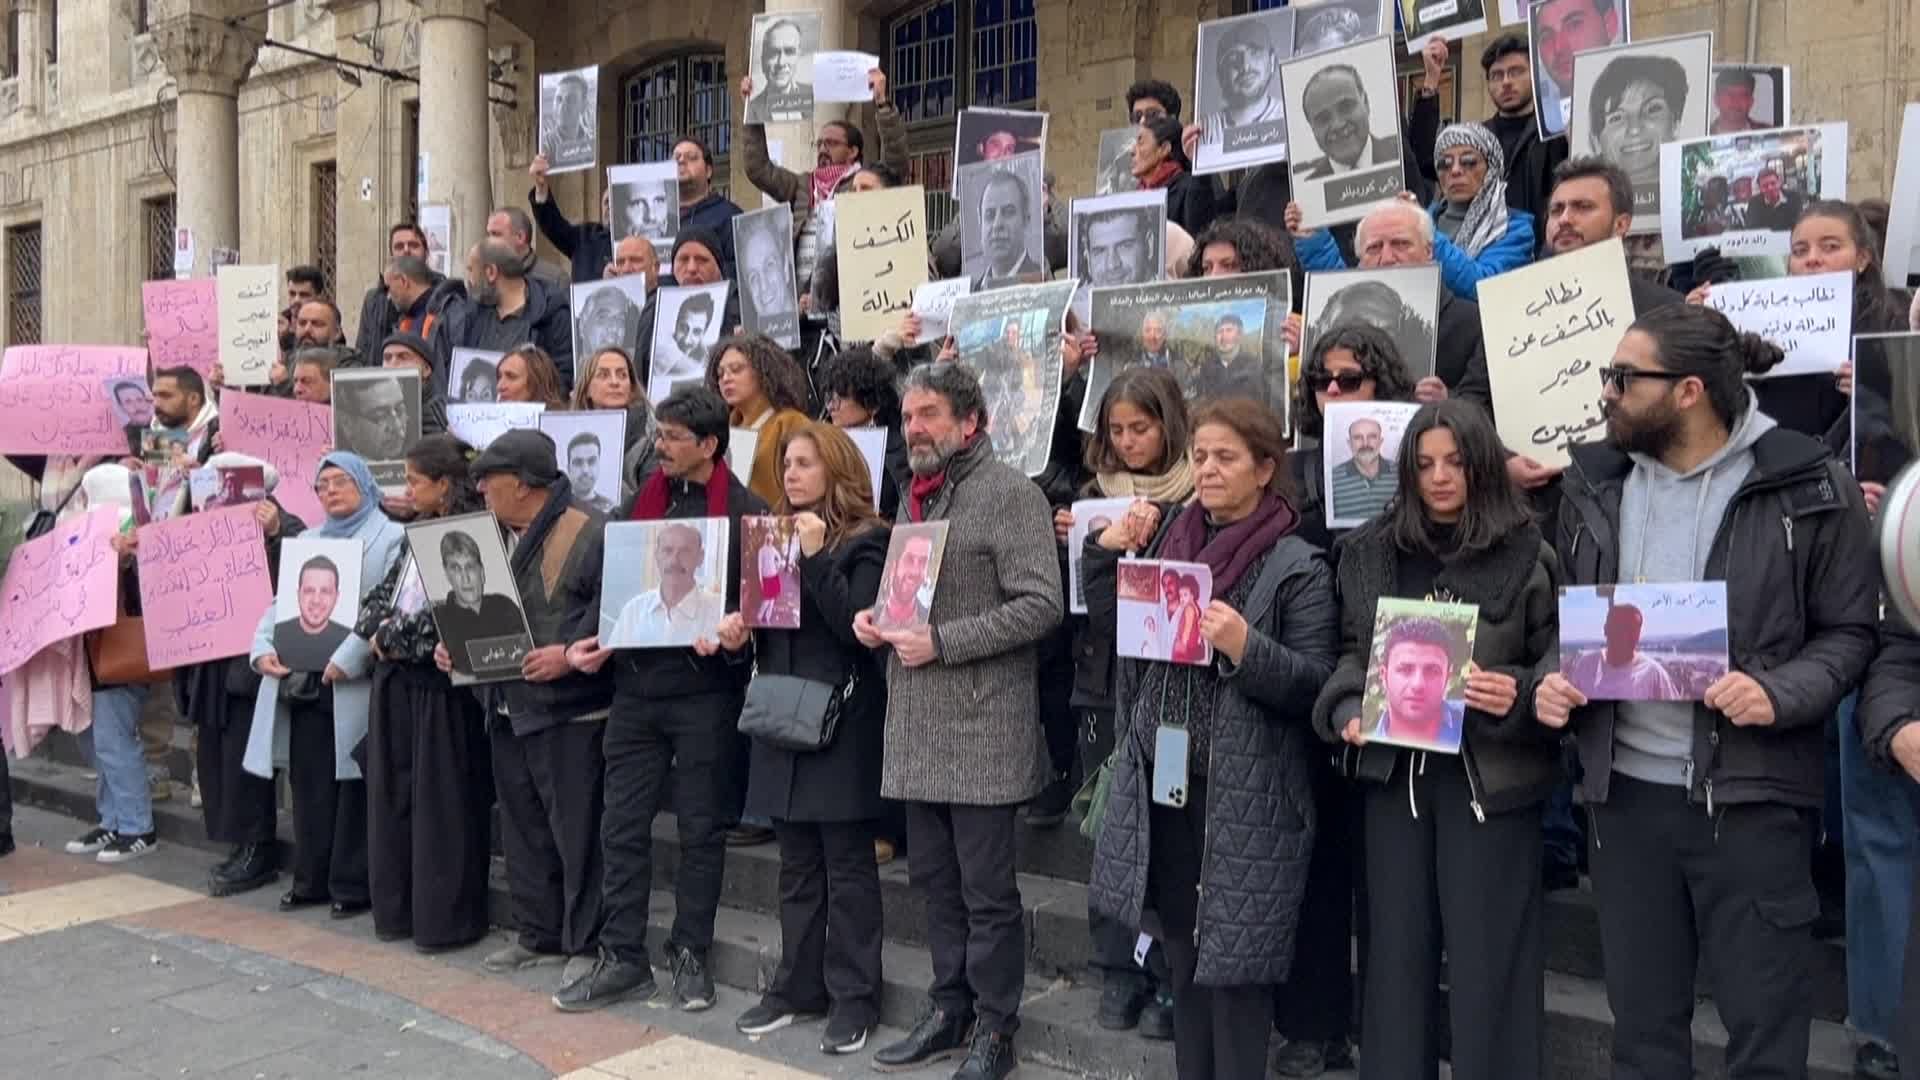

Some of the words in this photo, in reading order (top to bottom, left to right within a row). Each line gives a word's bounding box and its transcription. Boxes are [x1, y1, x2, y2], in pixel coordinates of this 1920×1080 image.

[853, 209, 915, 250] الكشف
[874, 260, 894, 278] و
[862, 288, 914, 315] لعدالة
[1526, 277, 1583, 317] نطالب
[1794, 287, 1835, 308] نطالب
[1540, 296, 1616, 348] بالكشف
[1507, 333, 1537, 358] عن
[1539, 358, 1592, 394] مصير
